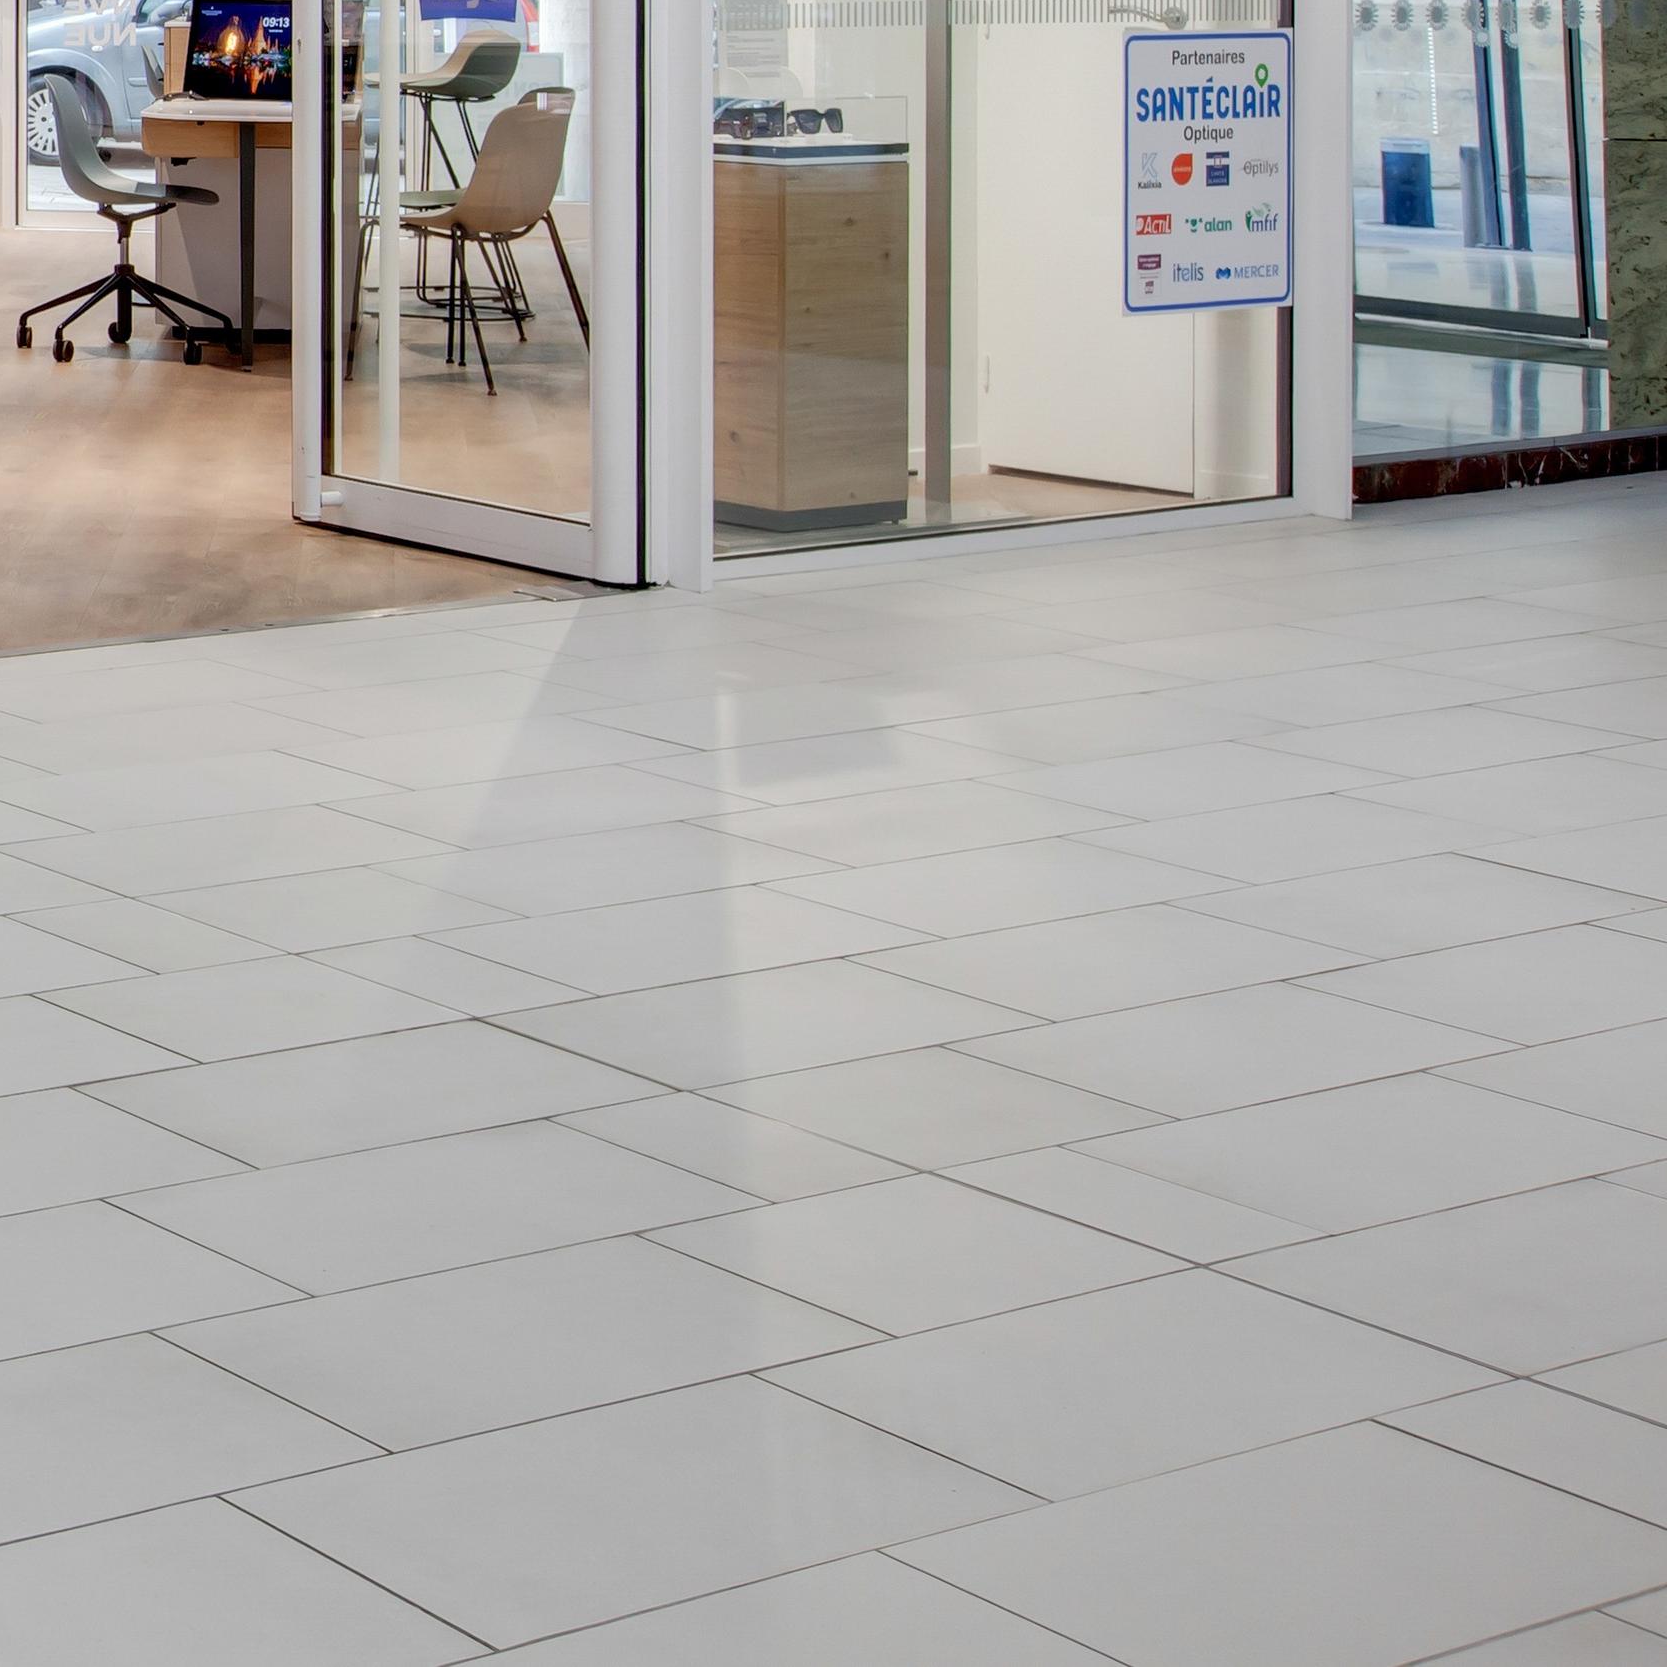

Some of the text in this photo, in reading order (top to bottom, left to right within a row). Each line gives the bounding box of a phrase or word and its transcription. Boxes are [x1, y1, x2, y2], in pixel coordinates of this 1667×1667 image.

[262, 16, 290, 29] 09:13
[1171, 50, 1245, 66] Partenaires
[1183, 125, 1234, 144] Optique
[1243, 158, 1279, 177] Optilys
[1204, 217, 1233, 232] alan
[1173, 263, 1204, 283] itelis
[1234, 264, 1279, 279] MERCER
